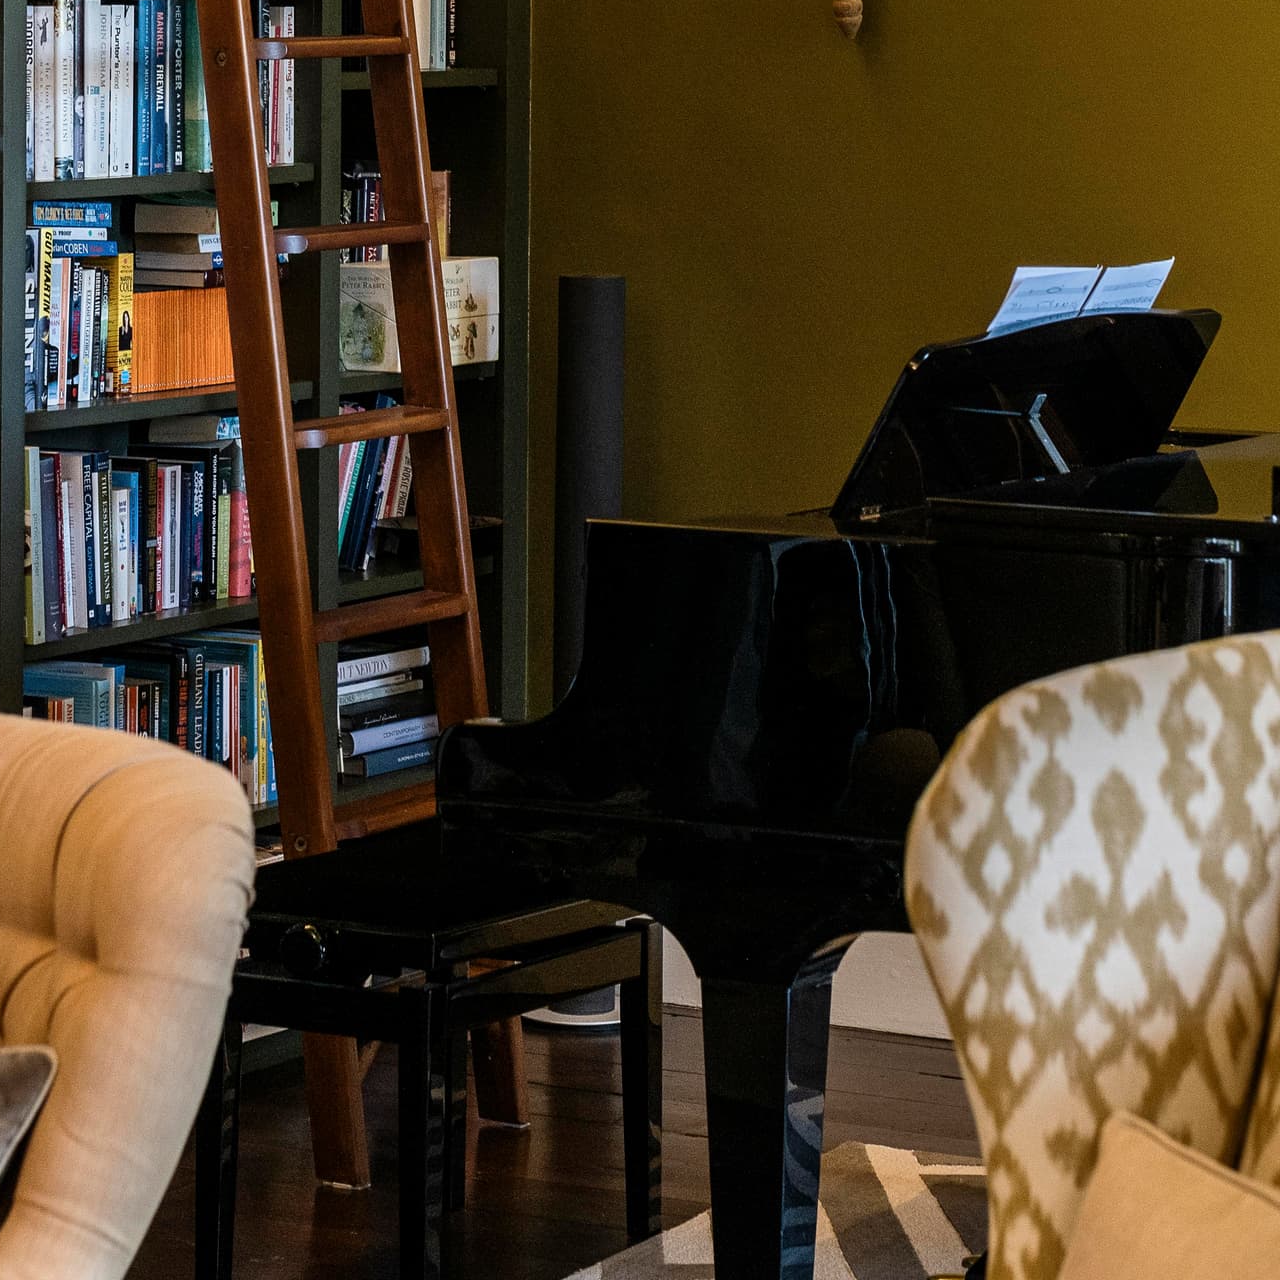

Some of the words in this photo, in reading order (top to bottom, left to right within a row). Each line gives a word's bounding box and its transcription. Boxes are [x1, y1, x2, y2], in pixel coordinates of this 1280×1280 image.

[156, 12, 164, 58] MANKELL
[156, 65, 164, 113] FIREWALL
[44, 232, 52, 260] GUY
[63, 243, 89, 255] COBEN
[43, 261, 51, 313] MARTIN
[341, 281, 361, 289] PETER
[84, 465, 92, 494] FREE
[102, 475, 110, 496] THE
[402, 466, 411, 491] ROSIE
[85, 496, 93, 542] CAPITAL
[102, 501, 110, 561] ESSENTIAL
[103, 563, 111, 600] BENNIS
[195, 655, 204, 710] GIULIANI
